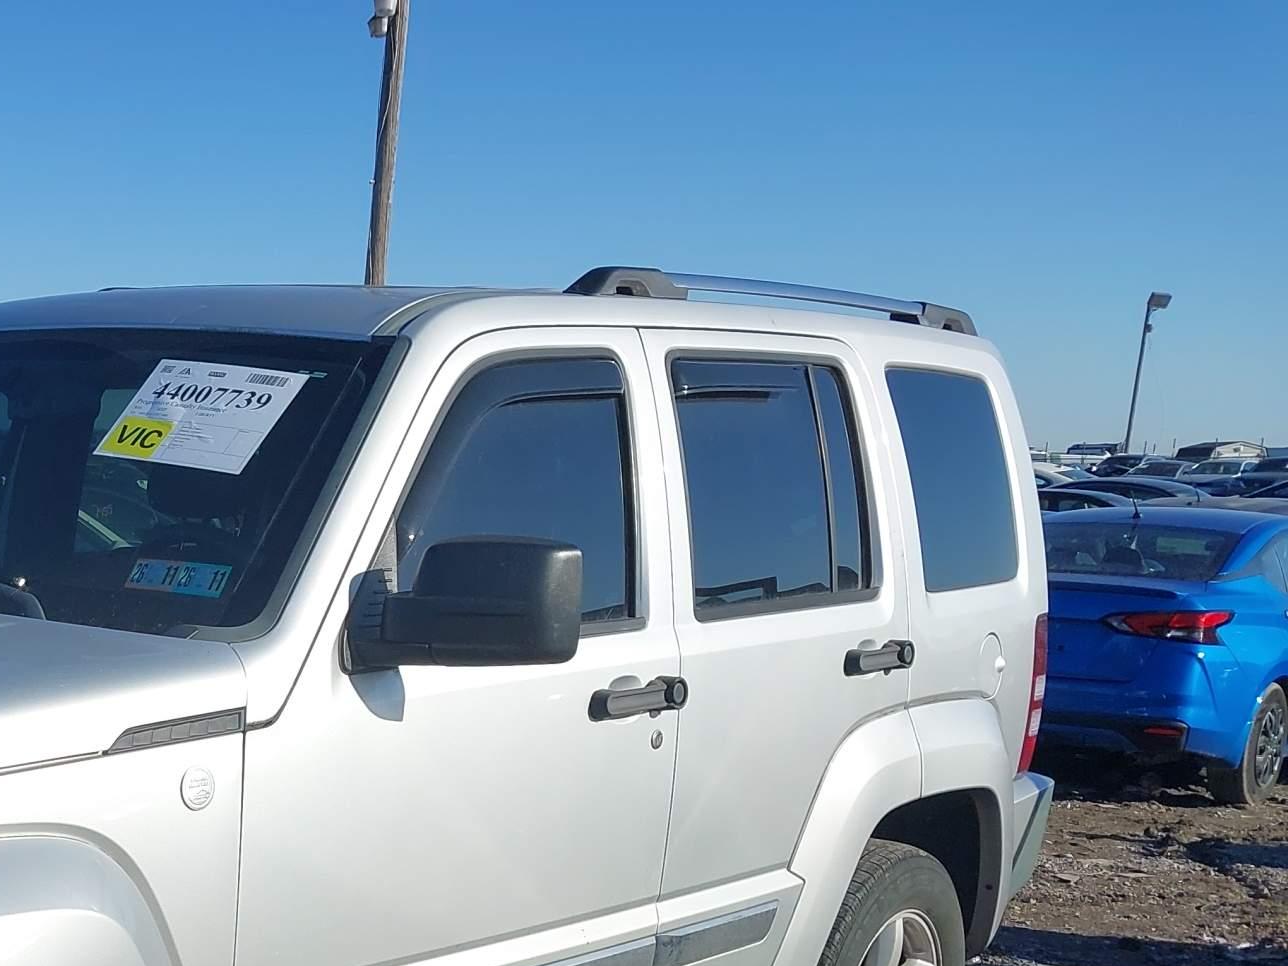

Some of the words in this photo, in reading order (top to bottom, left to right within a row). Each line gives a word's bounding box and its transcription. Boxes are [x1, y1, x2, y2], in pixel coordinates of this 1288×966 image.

[152, 382, 273, 410] 44007739
[117, 425, 164, 448] VIC
[208, 570, 227, 592] 11
